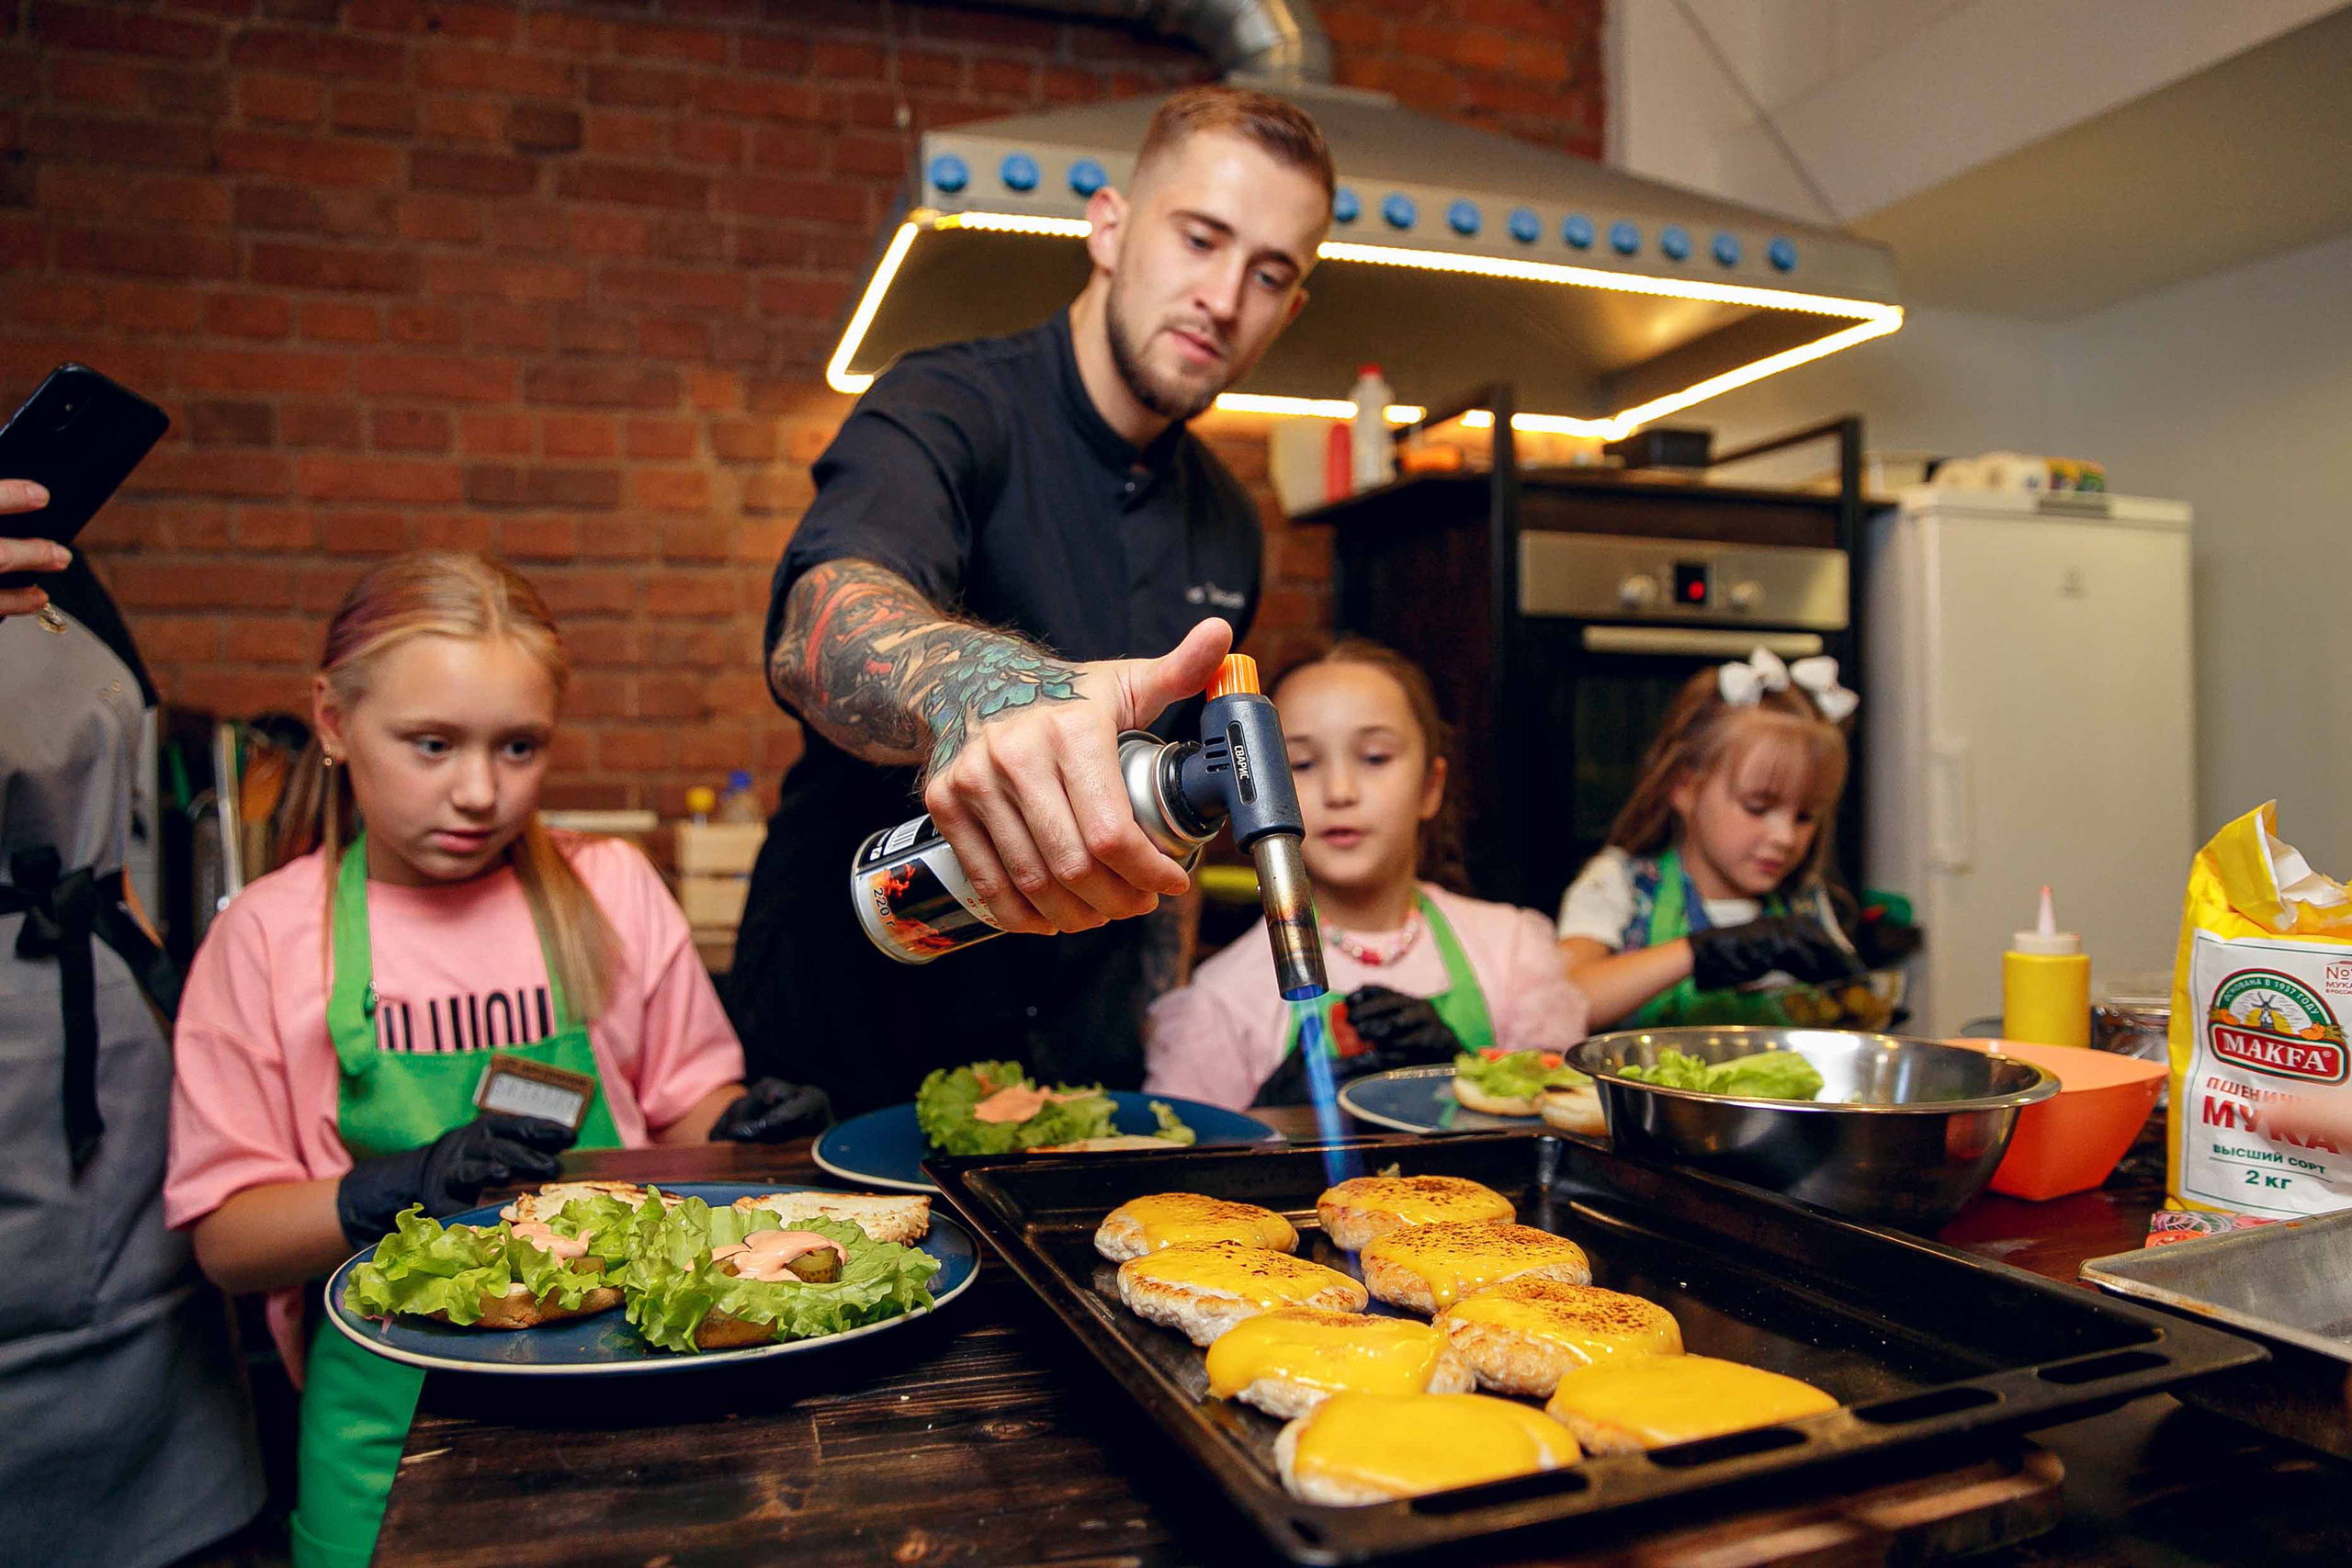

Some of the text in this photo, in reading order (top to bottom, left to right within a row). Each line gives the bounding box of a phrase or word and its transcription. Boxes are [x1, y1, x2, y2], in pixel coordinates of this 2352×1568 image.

[1234, 745, 1250, 780] СВАРИС
[874, 886, 890, 916] 220
[2274, 980, 2297, 995] 1937
[2297, 993, 2320, 1015] ГОДУ
[2212, 1144, 2326, 1174] ВЫСШИЙ СОРТ
[2245, 1169, 2260, 1185] 2
